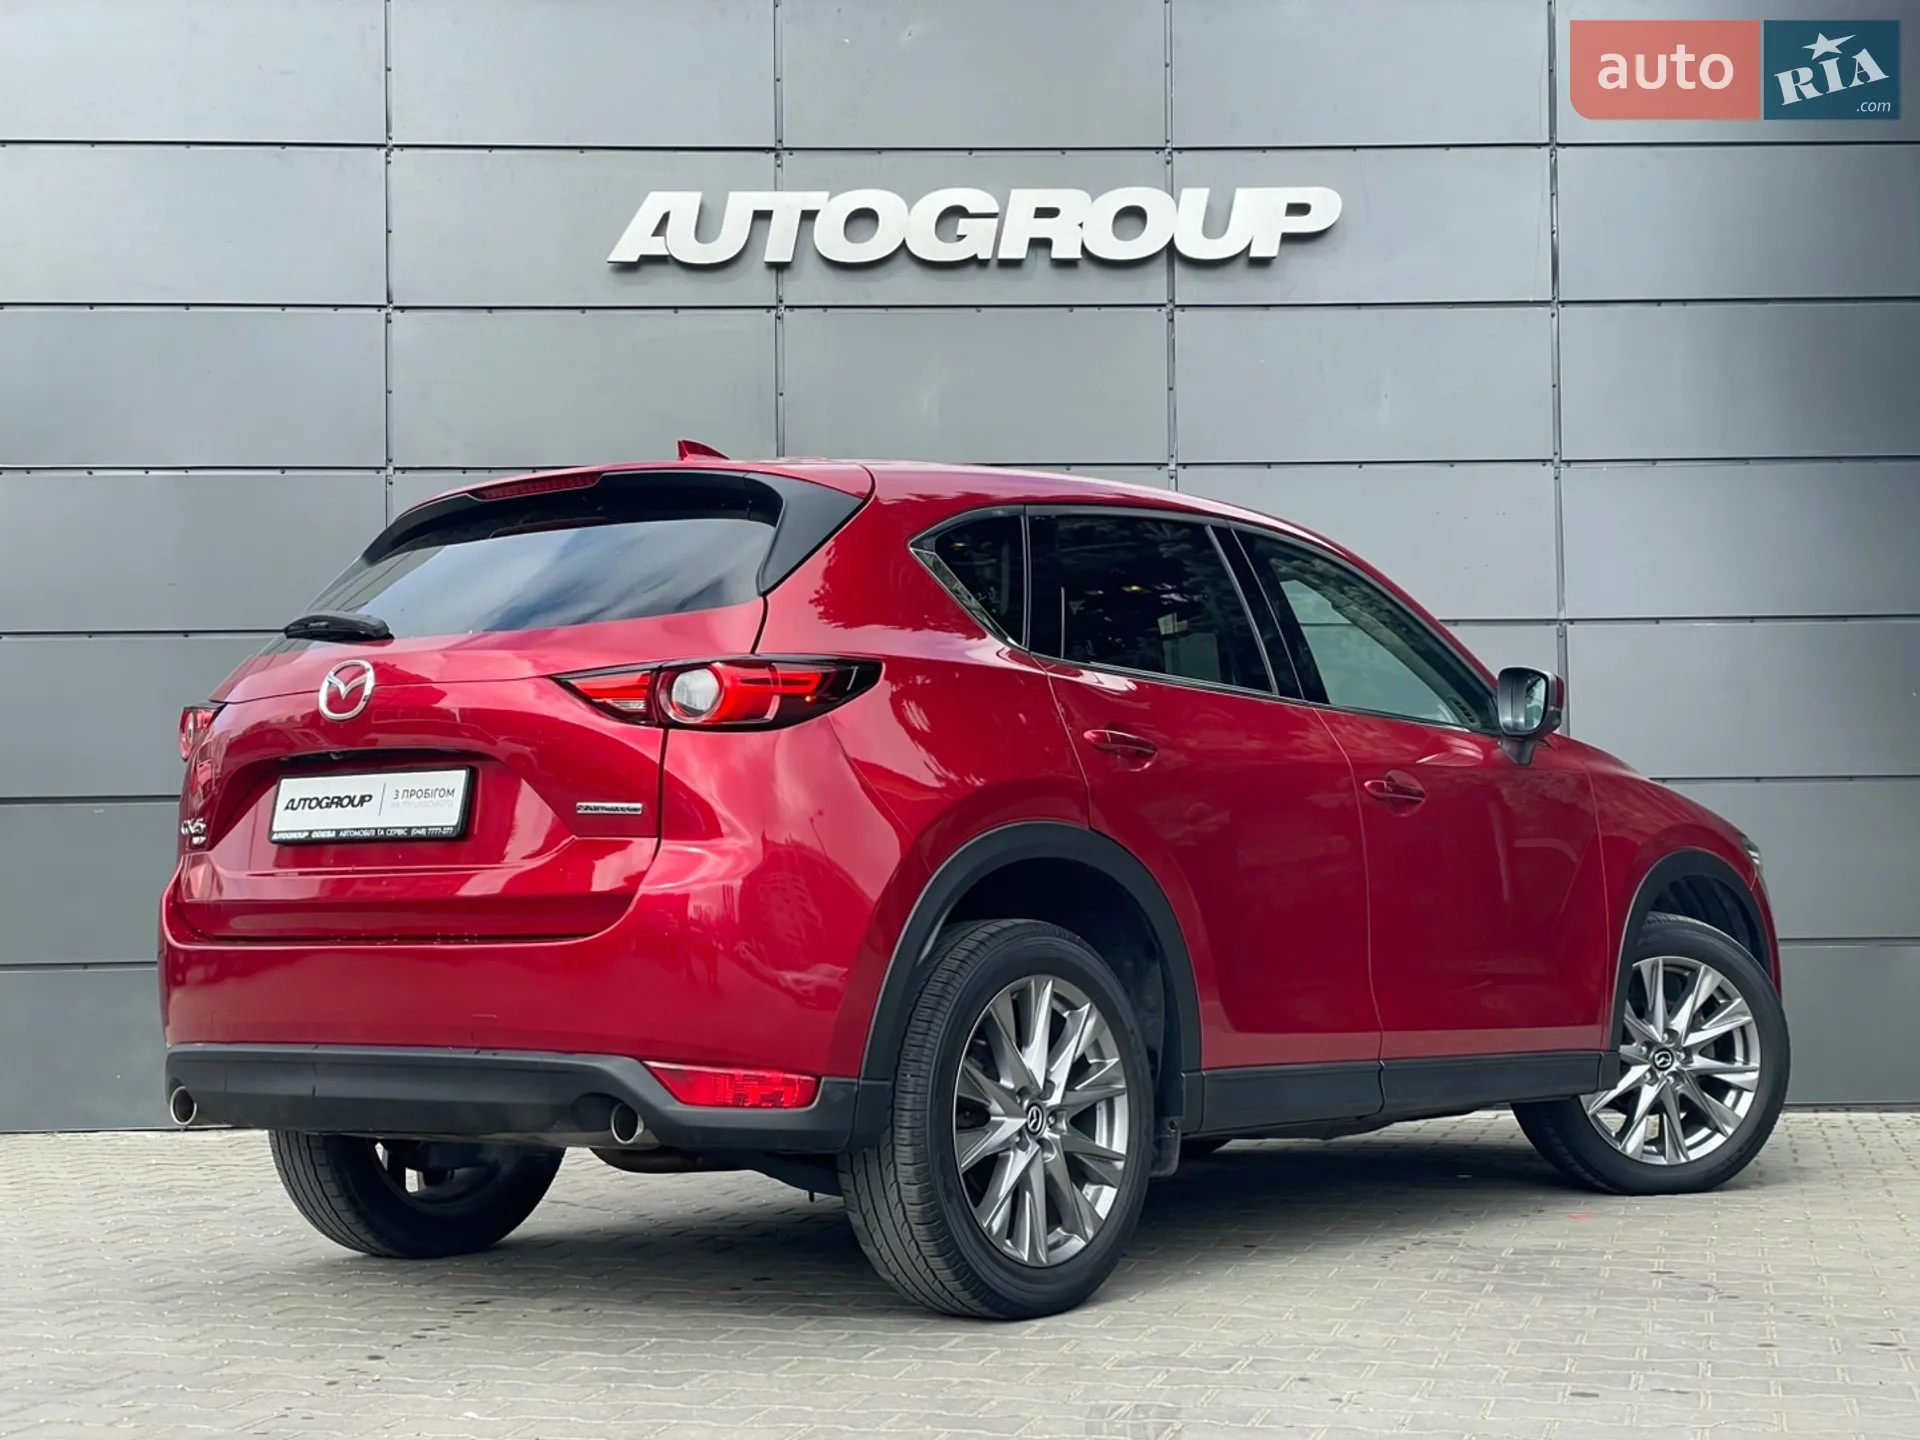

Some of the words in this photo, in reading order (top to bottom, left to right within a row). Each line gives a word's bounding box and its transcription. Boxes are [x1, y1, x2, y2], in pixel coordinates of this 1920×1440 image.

[606, 186, 1343, 265] AUTOGROUP
[393, 789, 400, 800] З
[402, 787, 455, 799] ПРОБІГОМ
[283, 794, 373, 811] AUTOGROUP
[377, 828, 385, 837] ТА
